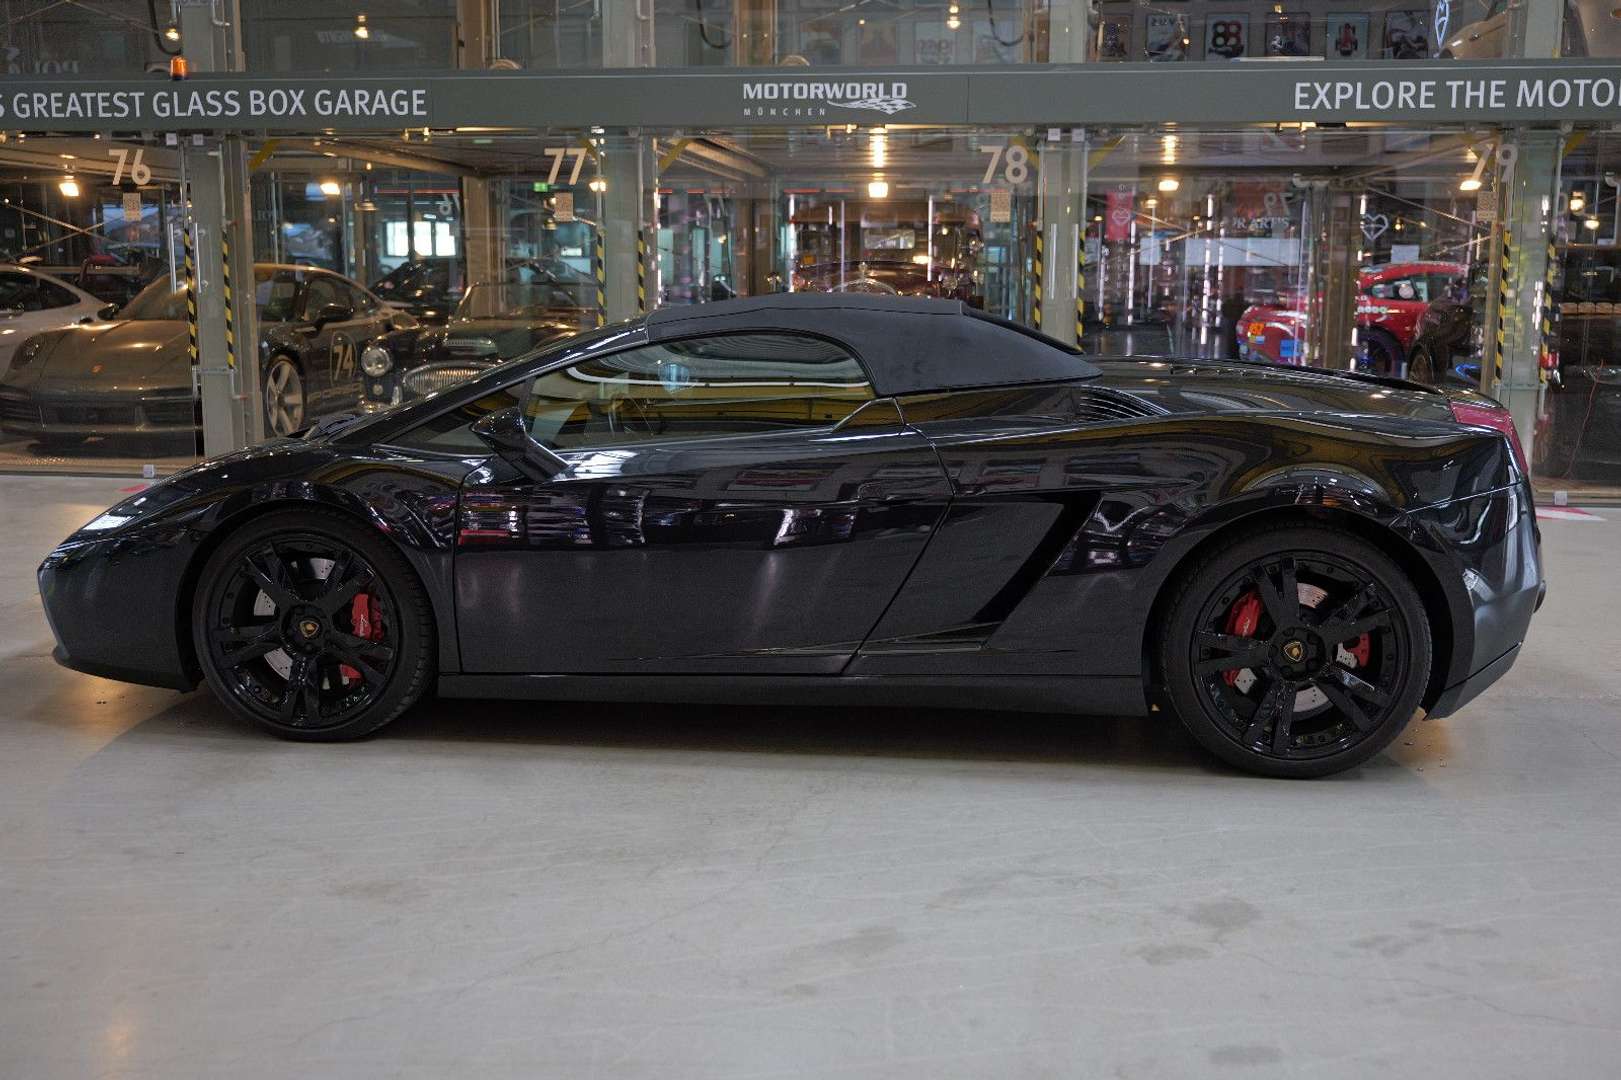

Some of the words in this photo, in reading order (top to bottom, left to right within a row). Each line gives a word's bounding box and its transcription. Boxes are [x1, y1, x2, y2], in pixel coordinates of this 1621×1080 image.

[13, 91, 145, 118] GREATEST
[152, 91, 241, 117] GLASS
[249, 90, 307, 116] BOX
[314, 89, 427, 116] GARAGE
[743, 82, 908, 100] MOTORWORLD
[1294, 81, 1437, 110] EXPLORE
[1445, 80, 1507, 109] THE
[1516, 78, 1621, 108] MOTO
[743, 106, 826, 117] MÜNCHEN
[107, 148, 151, 186] 76
[543, 147, 588, 186] 77
[979, 144, 1029, 184] 78
[1470, 143, 1519, 183] 79
[334, 344, 354, 380] 74
